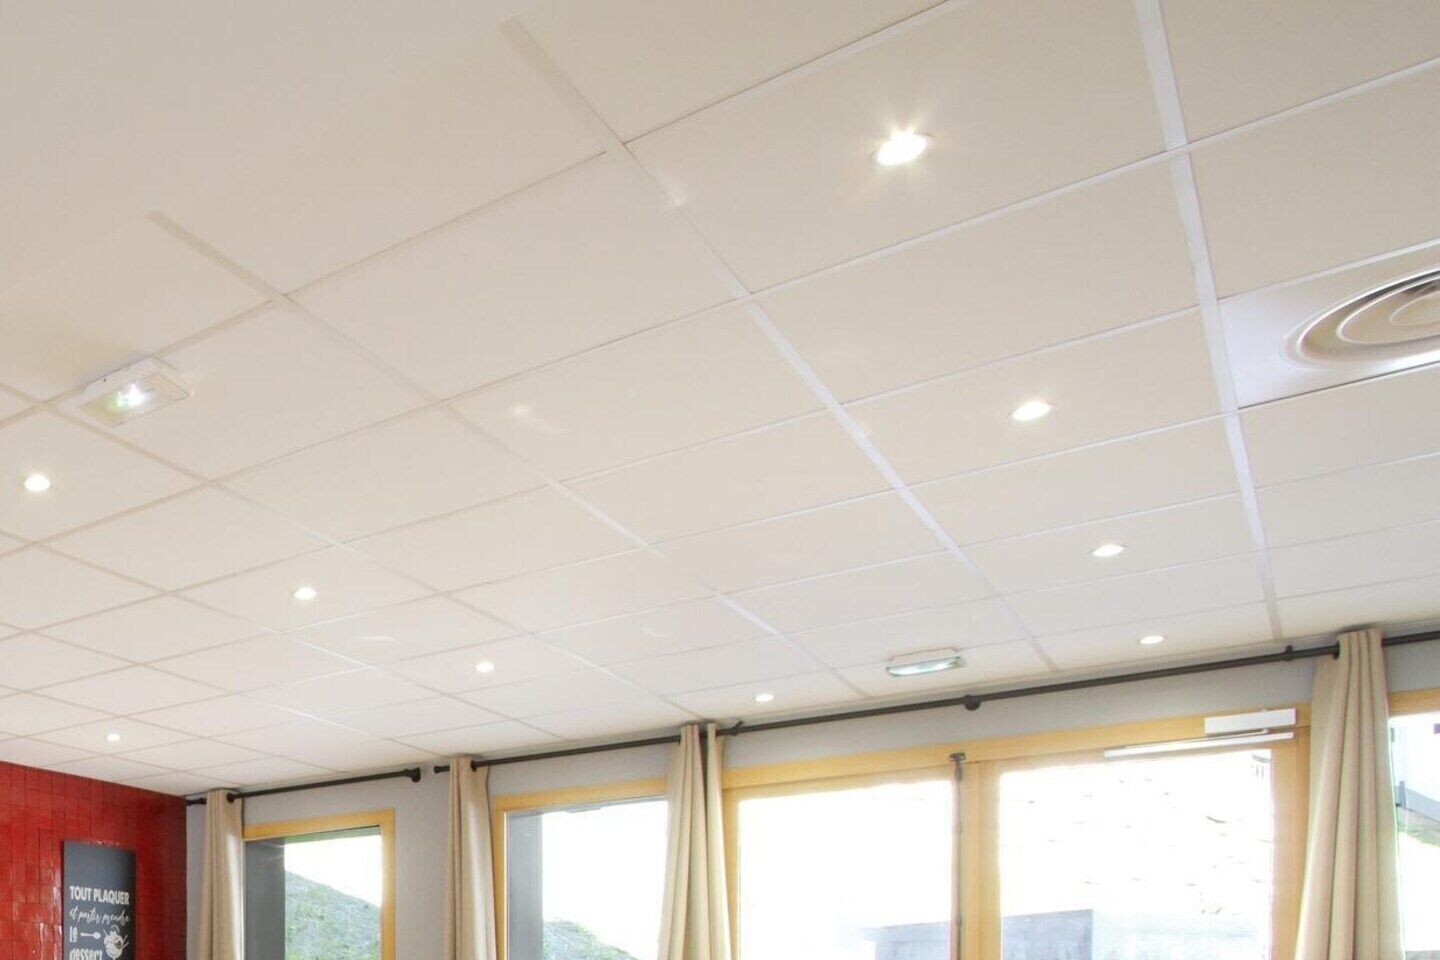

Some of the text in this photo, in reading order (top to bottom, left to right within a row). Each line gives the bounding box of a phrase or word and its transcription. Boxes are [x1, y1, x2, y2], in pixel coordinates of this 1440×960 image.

[69, 885, 130, 906] TOUT PLAQUER
[69, 905, 79, 920] et
